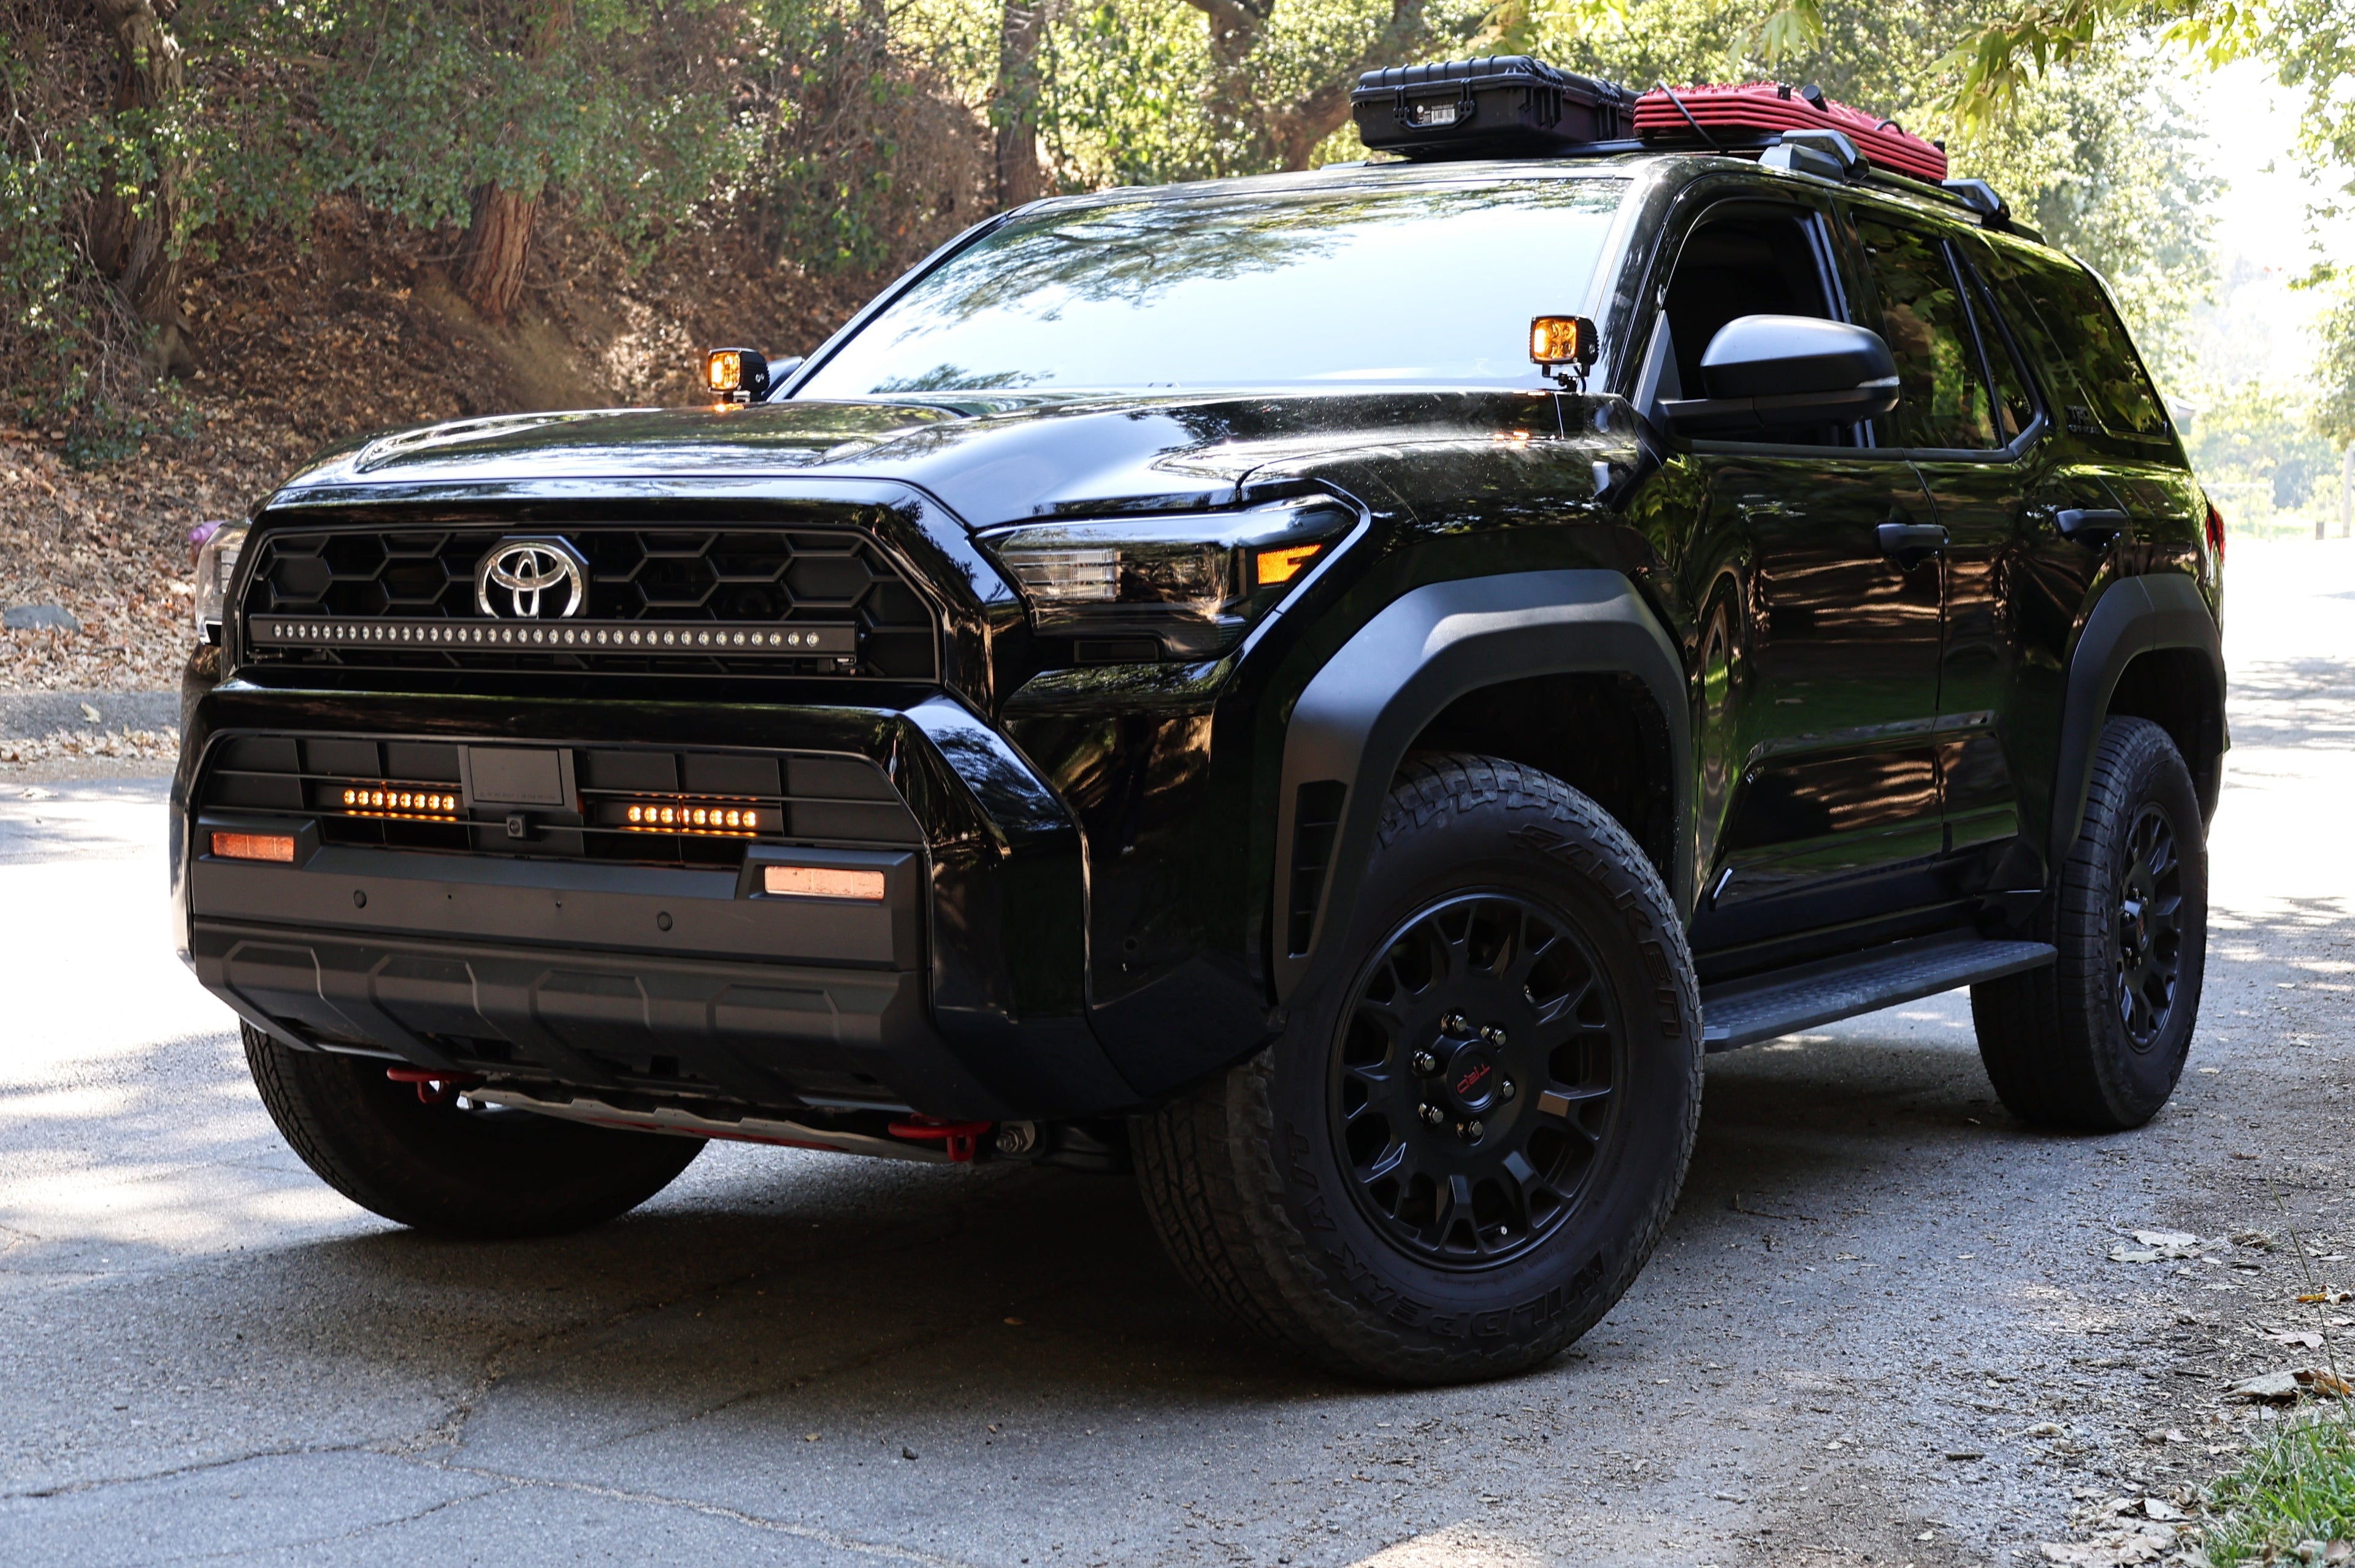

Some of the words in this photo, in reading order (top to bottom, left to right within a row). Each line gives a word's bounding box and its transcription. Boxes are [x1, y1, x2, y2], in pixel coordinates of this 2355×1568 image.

[1508, 824, 1682, 1038] FALKEN
[1457, 1063, 1492, 1095] TRD
[1326, 1241, 1605, 1339] WILDPEAK
